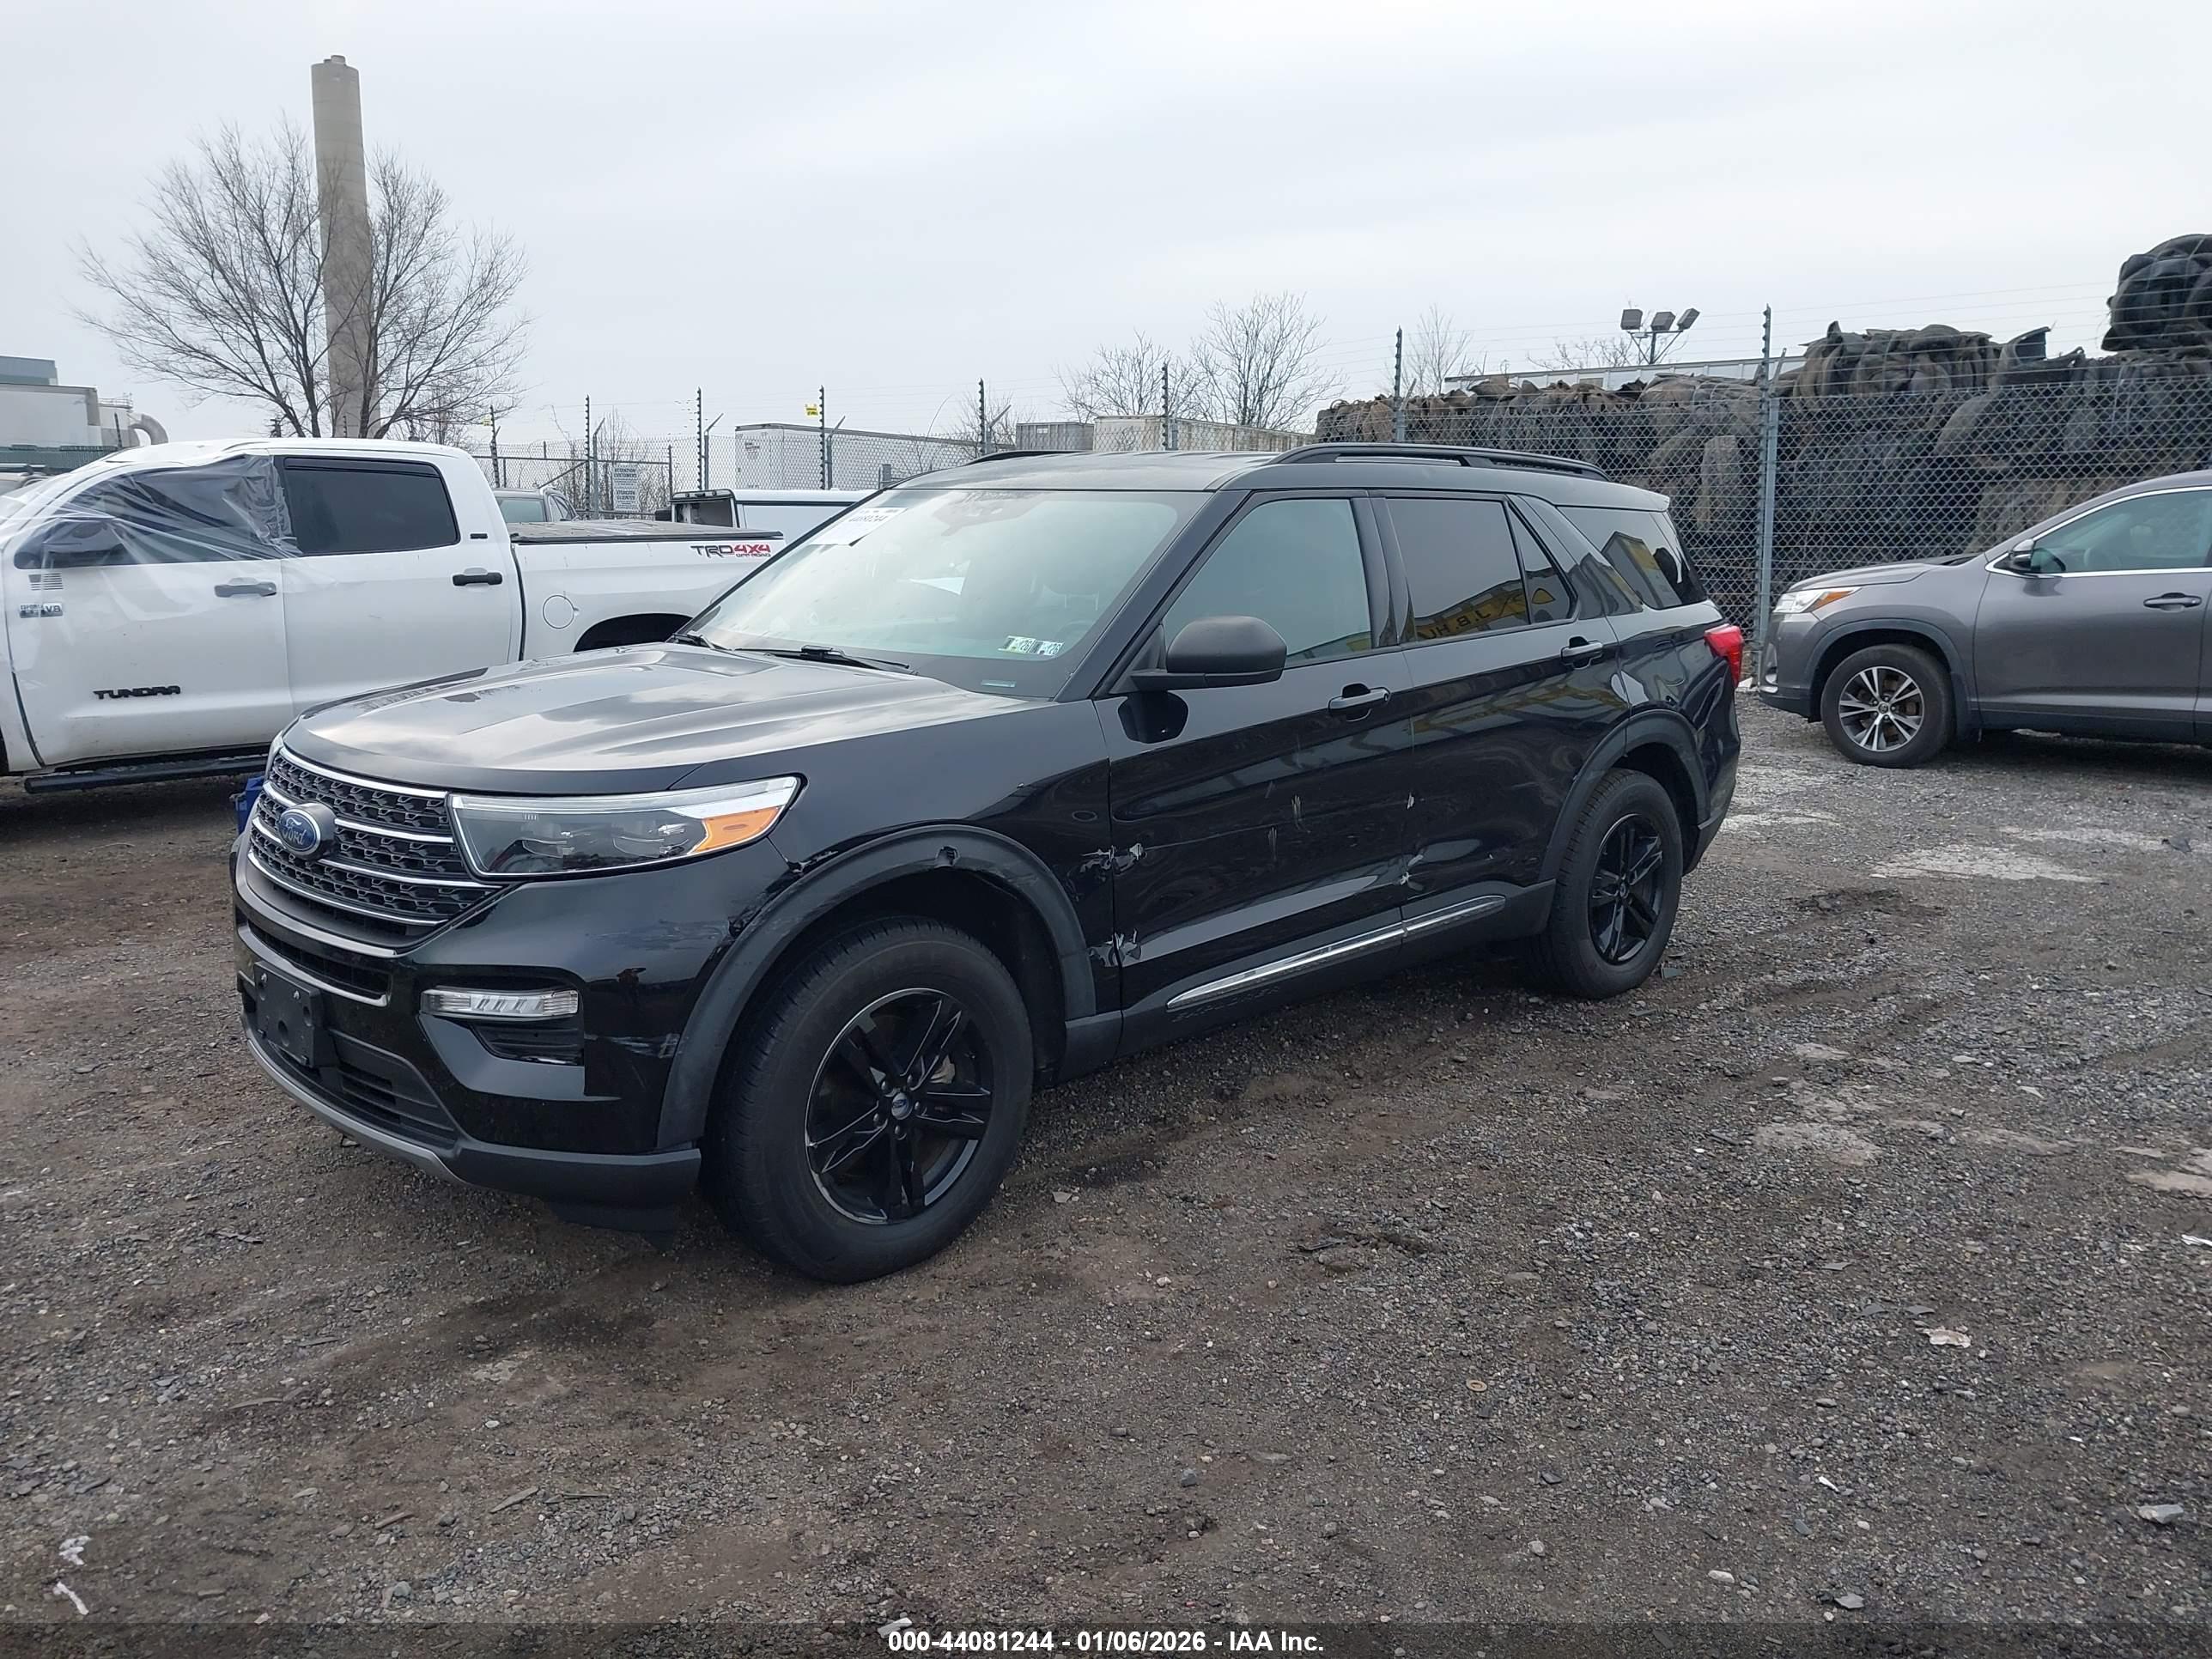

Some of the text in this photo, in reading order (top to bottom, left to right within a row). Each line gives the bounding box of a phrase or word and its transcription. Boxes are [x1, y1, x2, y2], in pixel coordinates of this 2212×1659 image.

[690, 544, 732, 558] TRD
[94, 685, 180, 700] TUNDRA
[282, 817, 307, 846] Ford
